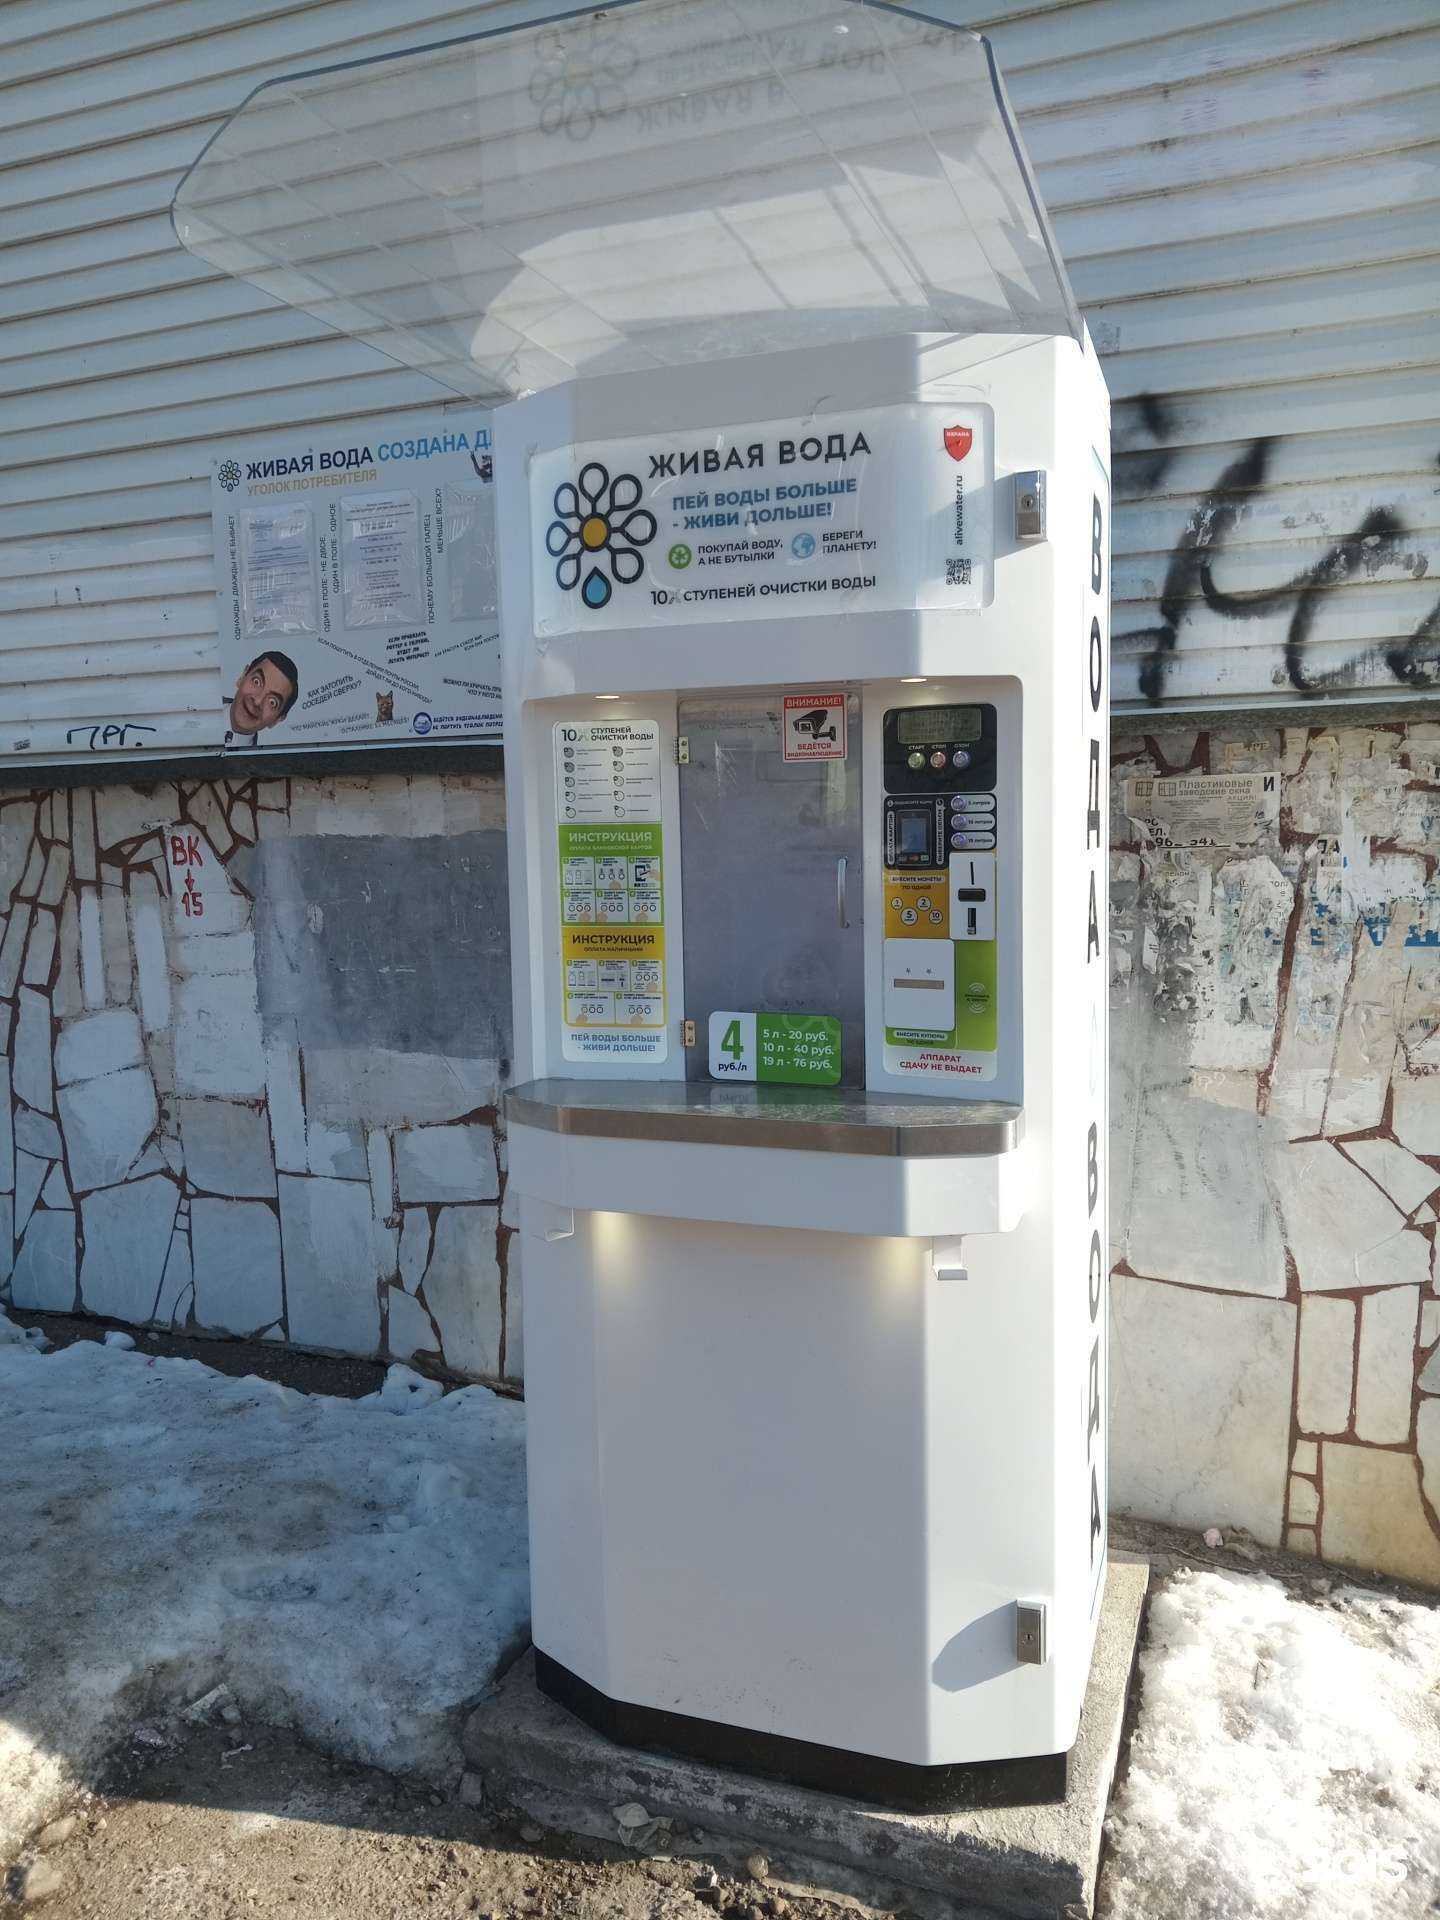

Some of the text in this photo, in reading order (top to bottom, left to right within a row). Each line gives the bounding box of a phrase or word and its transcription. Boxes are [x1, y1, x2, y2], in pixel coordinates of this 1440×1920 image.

[246, 455, 313, 481] ЖИВАЯ
[320, 447, 374, 471] ВОДА
[377, 432, 469, 462] СОЗДАНА
[649, 431, 872, 479] ЖИВАЯ ВОДА
[247, 469, 377, 497] УГОЛОК ПОТРЕБИТЕЛЯ
[672, 478, 857, 512] ПЕЙ ВОДЫ БОЛЬШЕ
[329, 503, 337, 532] ОДНОЕ
[684, 512, 740, 529] ЖИВИ
[745, 503, 832, 527] ДОЛЬШЕ!
[955, 475, 963, 546] alivewater.ru
[435, 518, 444, 553] МЕНЬШЕ
[823, 530, 863, 542] БЕРЕГИ
[230, 549, 236, 560] НЕ
[698, 538, 783, 555] ПОКУПАЙ ВОДУ,
[823, 541, 877, 555] ПЛАНЕТУ!
[321, 561, 327, 572] НЕ
[698, 551, 775, 566] А НЕ БУТЫЛКИ
[423, 514, 435, 624] ПОЧЕМУ БОЛЬШОЙ ПАЛЕЦ
[231, 562, 239, 596] ДВАЖДЫ
[331, 570, 340, 593] ОДИН
[650, 575, 877, 606] 10 СТУПЕНЕЙ ОЧИСТКИ ВОДЫ
[232, 599, 241, 640] ОДНАЖДЫ
[323, 609, 331, 632] ОДИН
[302, 680, 361, 710] СОСЕДЕЙ СВЕРХУ?
[307, 675, 354, 699] КАК ЗАТОПИТЬ
[786, 697, 842, 707] ВНИМАНИЕ!
[561, 726, 632, 742] 10 СТУПЕНЕЙ
[1087, 492, 1102, 964] ВОДА
[1178, 779, 1253, 789] Пластиковые
[1179, 787, 1227, 796] заводские
[569, 831, 653, 843] ИНСТРУКЦИЯ
[181, 892, 204, 917] 15
[906, 911, 913, 919] 5
[572, 934, 655, 946] ИНСТРУКЦИЯ
[570, 1033, 662, 1044] ПЕЙ ВОДЫ БОЛЬШЕ
[721, 1020, 744, 1060] 4
[763, 1029, 769, 1038] 5
[789, 1030, 802, 1040] 20
[805, 1031, 828, 1042] руб.
[582, 1043, 656, 1053] ЖИВИ ДОЛЬШЕ!
[763, 1043, 774, 1052] 10
[794, 1045, 808, 1054] 40
[811, 1045, 834, 1056] руб.
[718, 1062, 747, 1071] руб./л
[763, 1056, 773, 1066] 19
[793, 1058, 806, 1068] 76
[809, 1059, 832, 1070] руб.
[920, 1053, 962, 1063] АППАРАТ
[900, 1062, 983, 1073] СДАЧУ НЕ ВЫДАЕТ
[1087, 1120, 1102, 1570] ВОДА
